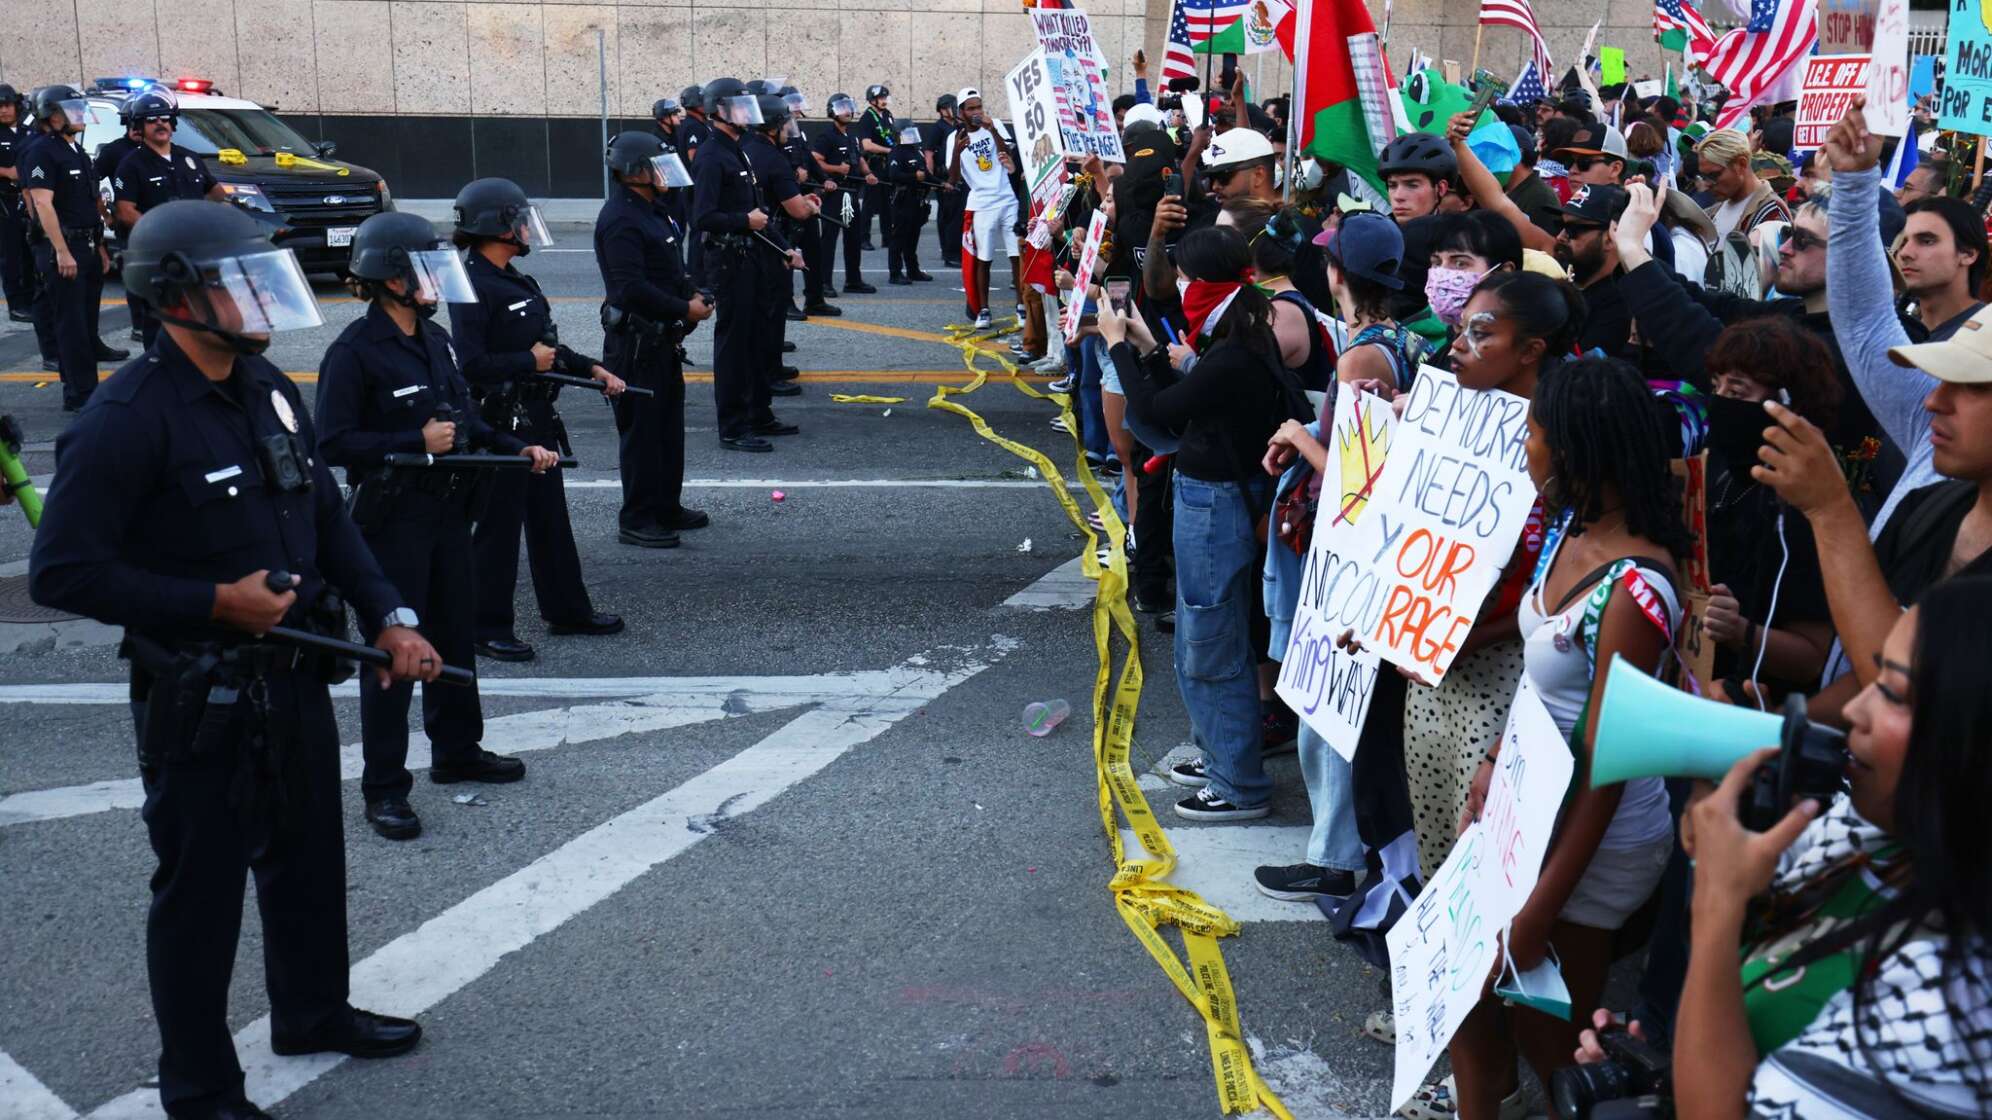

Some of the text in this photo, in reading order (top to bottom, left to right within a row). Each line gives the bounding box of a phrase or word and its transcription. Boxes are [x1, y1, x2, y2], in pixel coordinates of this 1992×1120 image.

[1034, 13, 1088, 38] WHAT KILLED
[1826, 12, 1852, 44] STOP
[1832, 62, 1859, 87] OFF
[1956, 40, 1992, 80] MOR
[1013, 57, 1042, 102] YES
[1026, 93, 1036, 107] ON
[1943, 85, 1970, 118] POR
[1024, 102, 1045, 140] 50
[967, 137, 991, 152] WHAT
[1063, 128, 1080, 153] THE
[1399, 448, 1512, 538] NEEDS
[1372, 513, 1475, 600] YOUR
[1324, 560, 1472, 675] COURAGE
[1282, 610, 1376, 728] King WAY
